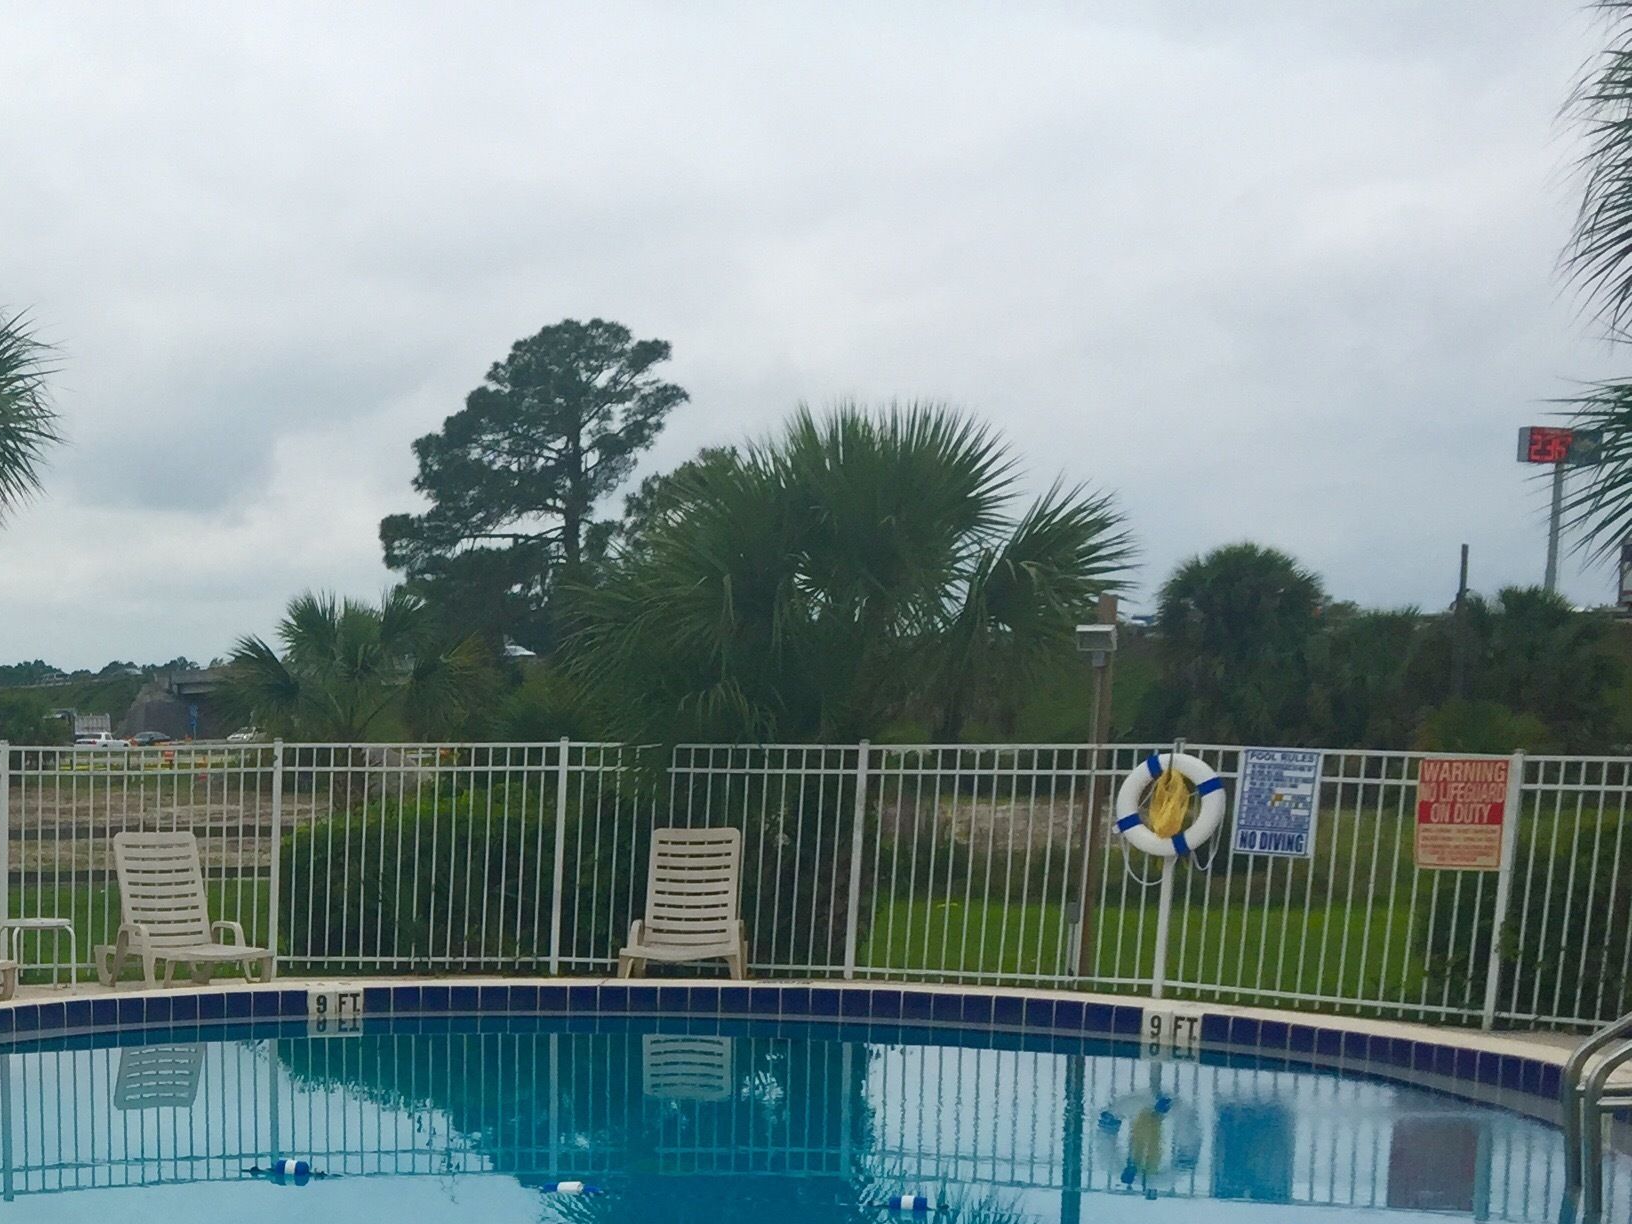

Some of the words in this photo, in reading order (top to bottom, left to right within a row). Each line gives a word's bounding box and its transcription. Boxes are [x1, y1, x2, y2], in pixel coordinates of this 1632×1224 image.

[1249, 750, 1278, 761] POOL
[1280, 752, 1315, 763] RULES
[1423, 761, 1507, 783] WARNING
[1438, 781, 1506, 803] LIFEGUARD
[1430, 803, 1451, 824] ON
[1452, 803, 1493, 824] DUTY
[1238, 830, 1257, 850] NO
[1258, 831, 1305, 853] DIVING
[316, 994, 328, 1014] 9
[1150, 1014, 1162, 1038] 9
